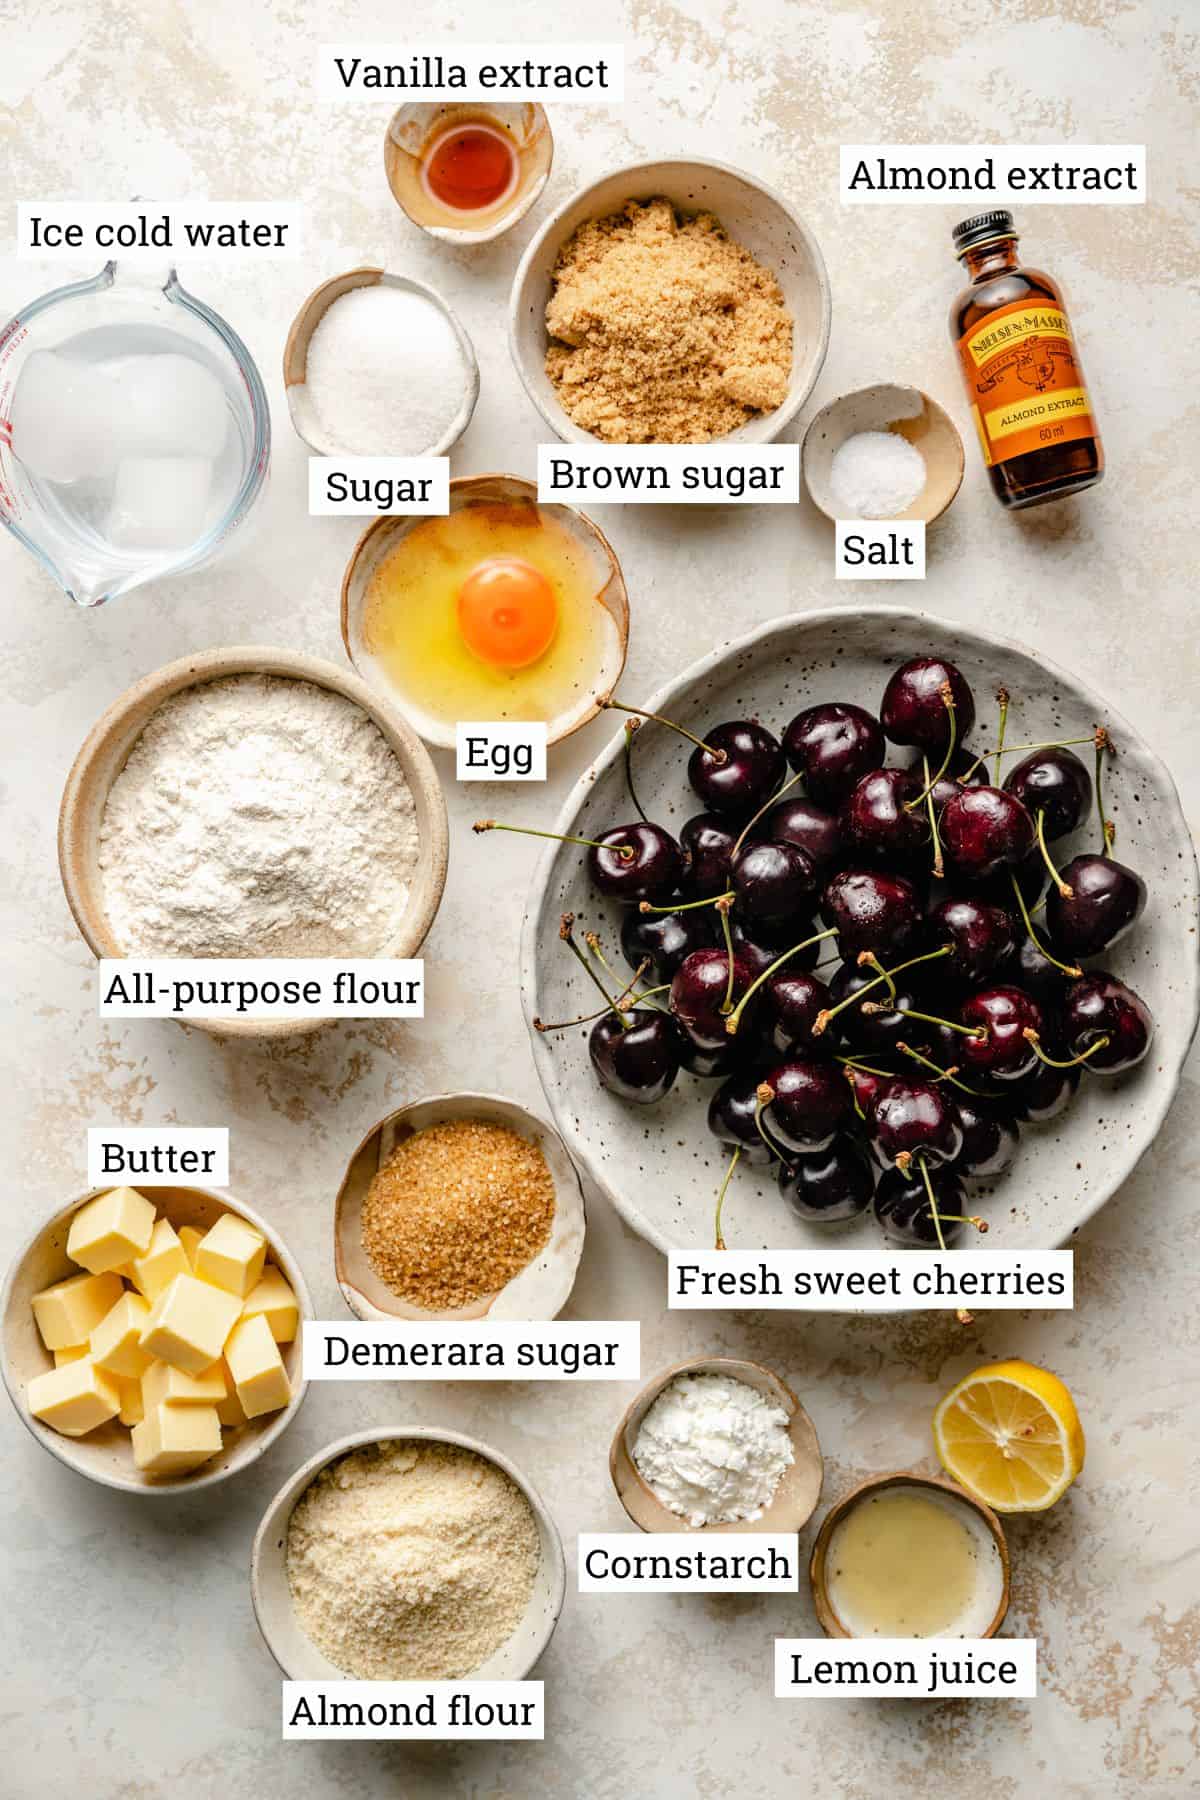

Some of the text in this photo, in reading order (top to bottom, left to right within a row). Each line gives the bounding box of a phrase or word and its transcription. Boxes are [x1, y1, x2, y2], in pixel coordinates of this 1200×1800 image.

[1001, 397, 1085, 427] ALMOND EXTRACT
[1039, 425, 1065, 441] 60 ml
